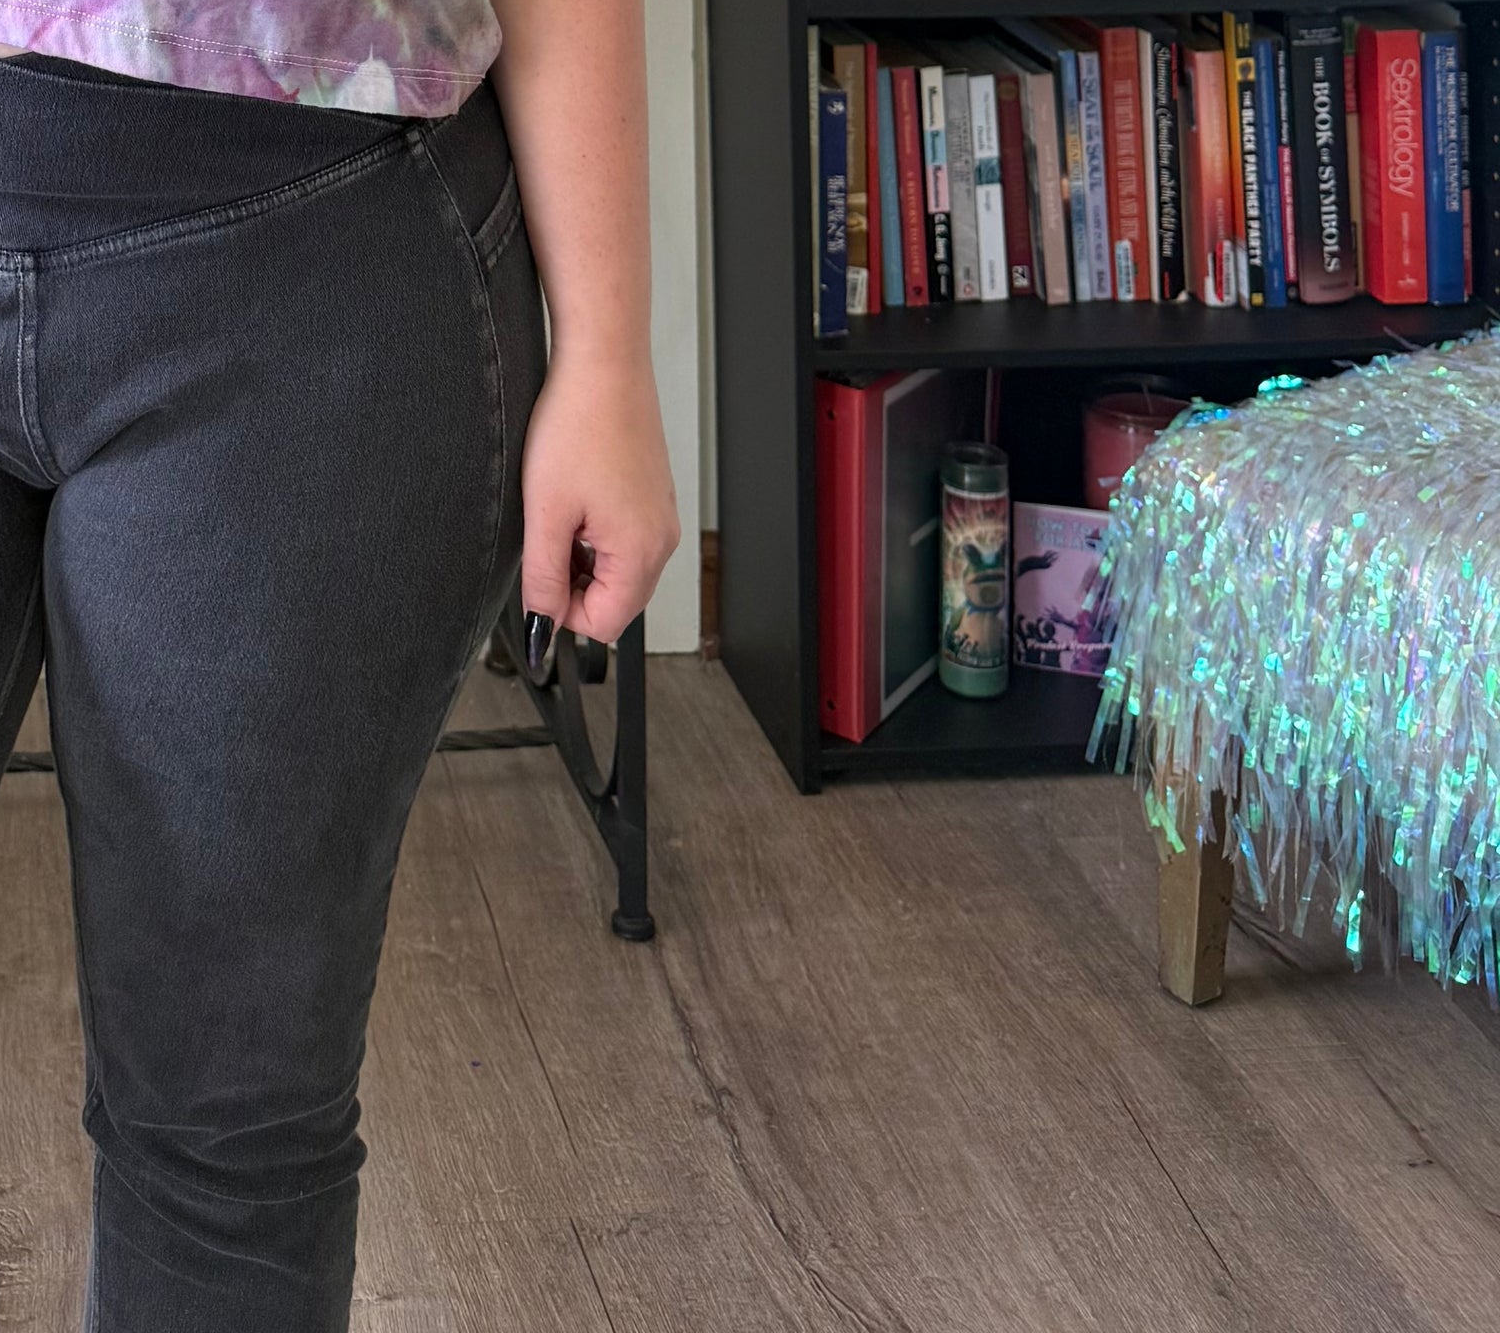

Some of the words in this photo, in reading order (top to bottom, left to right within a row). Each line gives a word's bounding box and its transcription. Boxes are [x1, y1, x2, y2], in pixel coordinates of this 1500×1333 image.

[1243, 108, 1257, 152] BLACK
[1313, 82, 1333, 147] BOOK
[1387, 57, 1419, 198] Sextrology
[1244, 155, 1259, 217] PANTHER
[1247, 220, 1263, 267] PARTY
[1318, 165, 1341, 273] SYMBOLS
